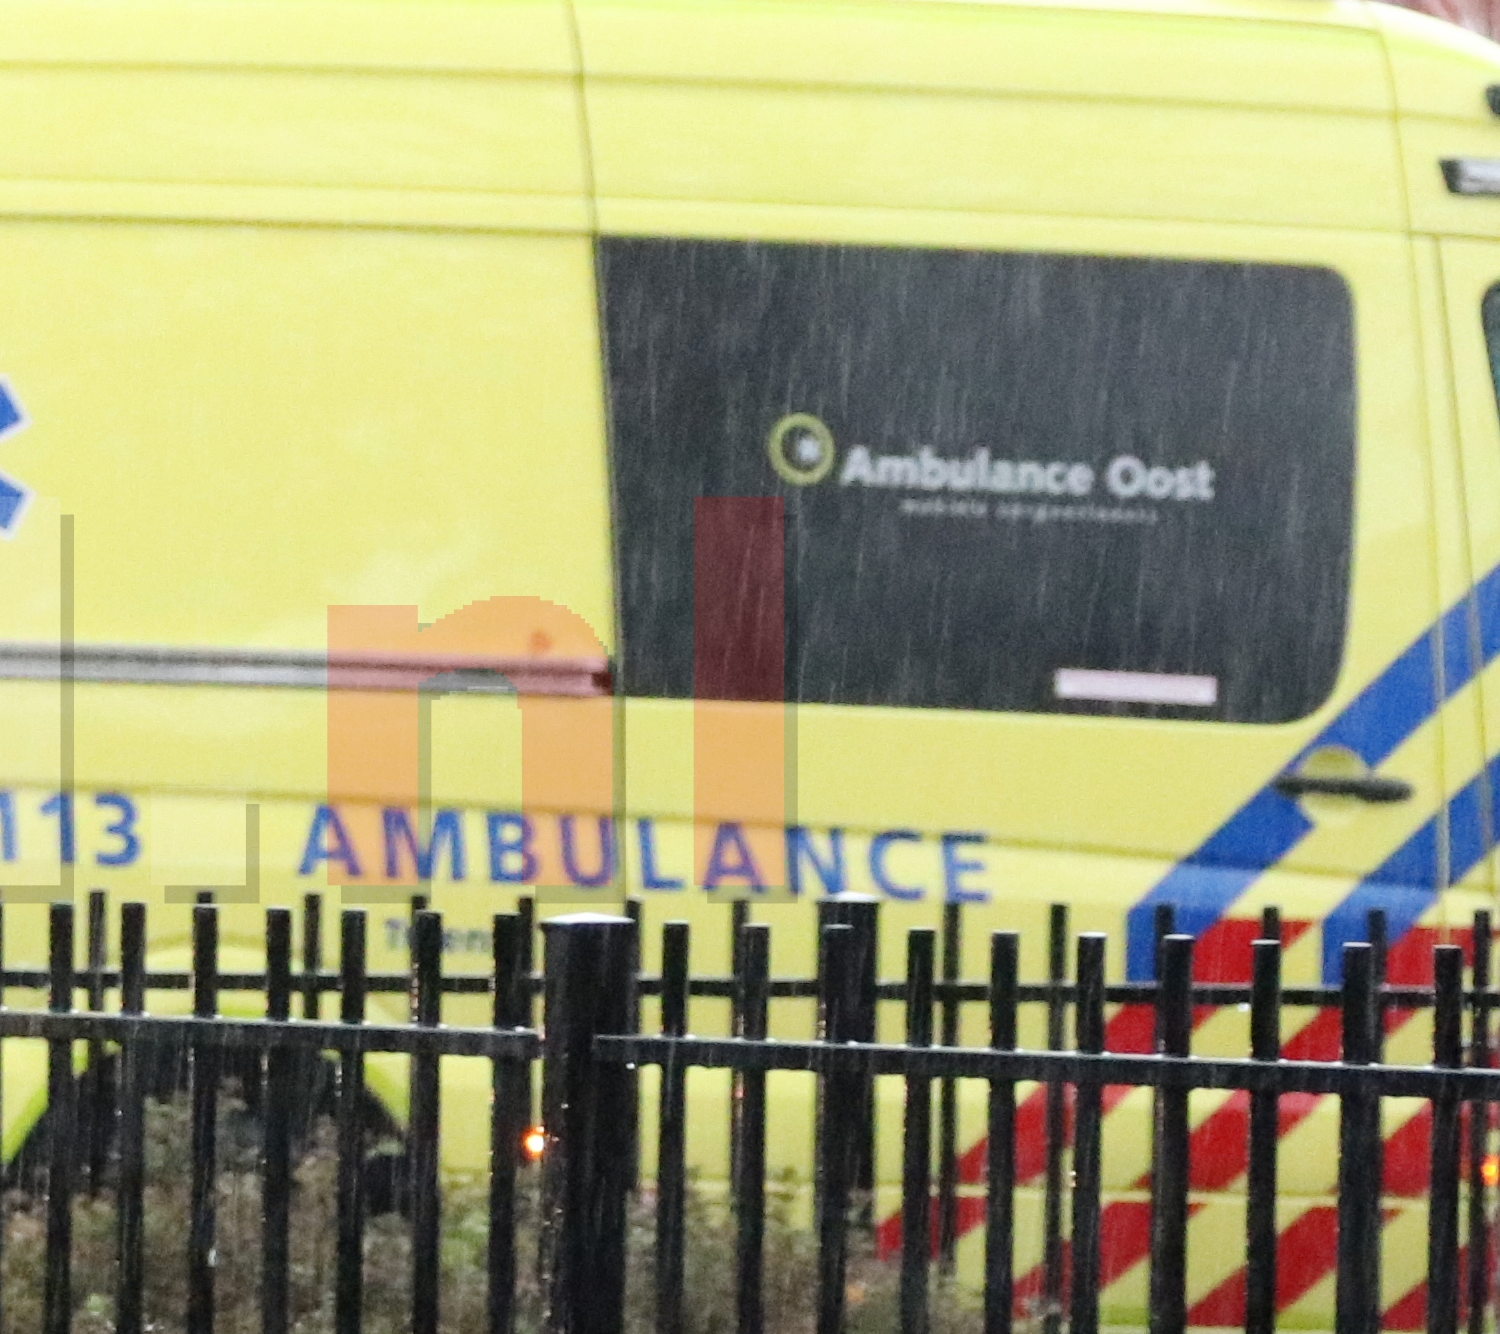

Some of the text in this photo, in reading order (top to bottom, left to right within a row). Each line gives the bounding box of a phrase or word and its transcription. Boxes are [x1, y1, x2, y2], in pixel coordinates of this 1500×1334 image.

[841, 443, 1215, 501] Ambulance Oost
[299, 803, 994, 904] AMBULANCE
